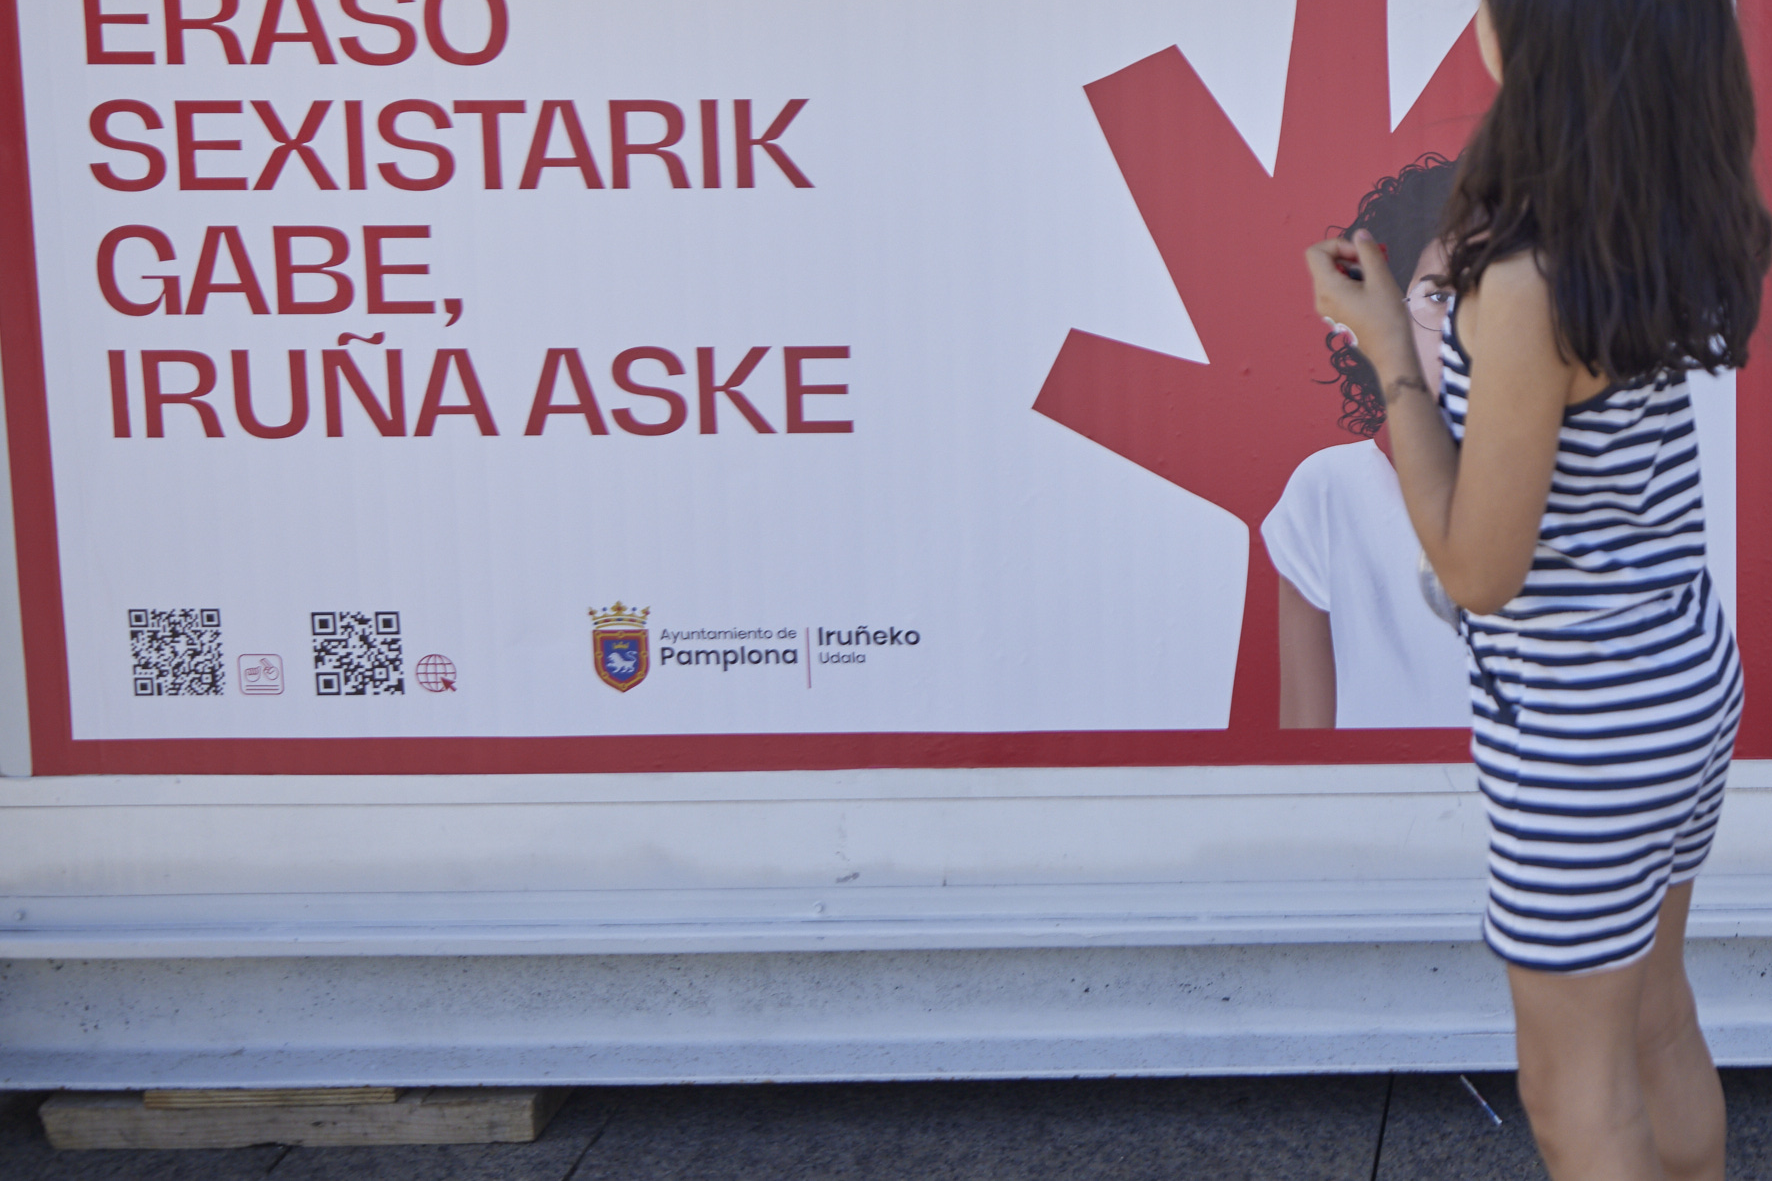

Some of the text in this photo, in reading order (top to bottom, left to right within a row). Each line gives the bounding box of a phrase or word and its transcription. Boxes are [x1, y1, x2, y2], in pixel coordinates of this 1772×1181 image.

[88, 98, 816, 192] SEXISTARIK
[95, 224, 464, 328] GABE,
[107, 330, 856, 440] IRUÑA ASKE
[659, 626, 798, 645] Ayuntamiento de
[817, 625, 922, 647] Iruñeko
[660, 645, 799, 672] Pamplona
[818, 650, 867, 665] Udala
